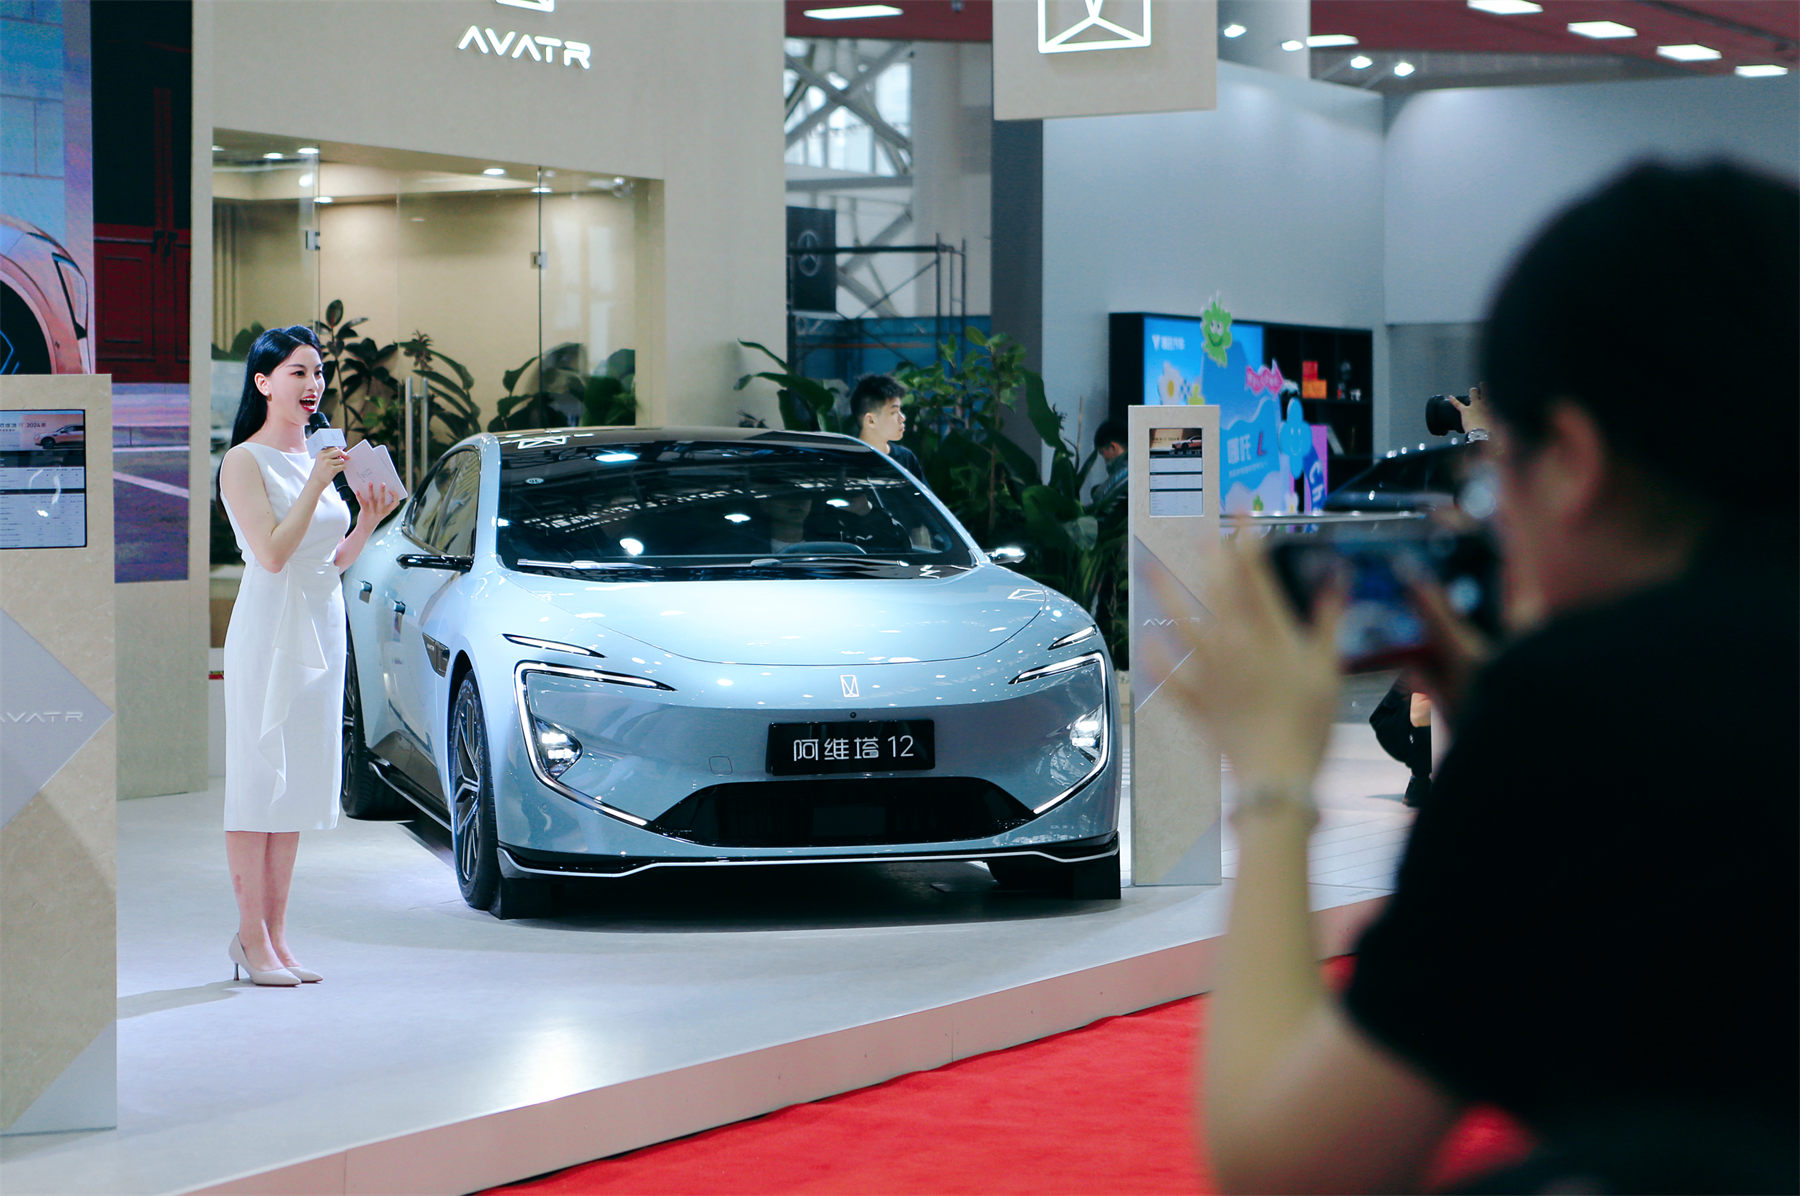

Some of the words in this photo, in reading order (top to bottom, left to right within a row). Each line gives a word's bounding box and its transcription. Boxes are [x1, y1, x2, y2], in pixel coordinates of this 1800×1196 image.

[457, 25, 592, 70] AVATR
[0, 711, 84, 723] VATR
[793, 736, 879, 761] 阿维塔
[887, 735, 914, 758] 12
